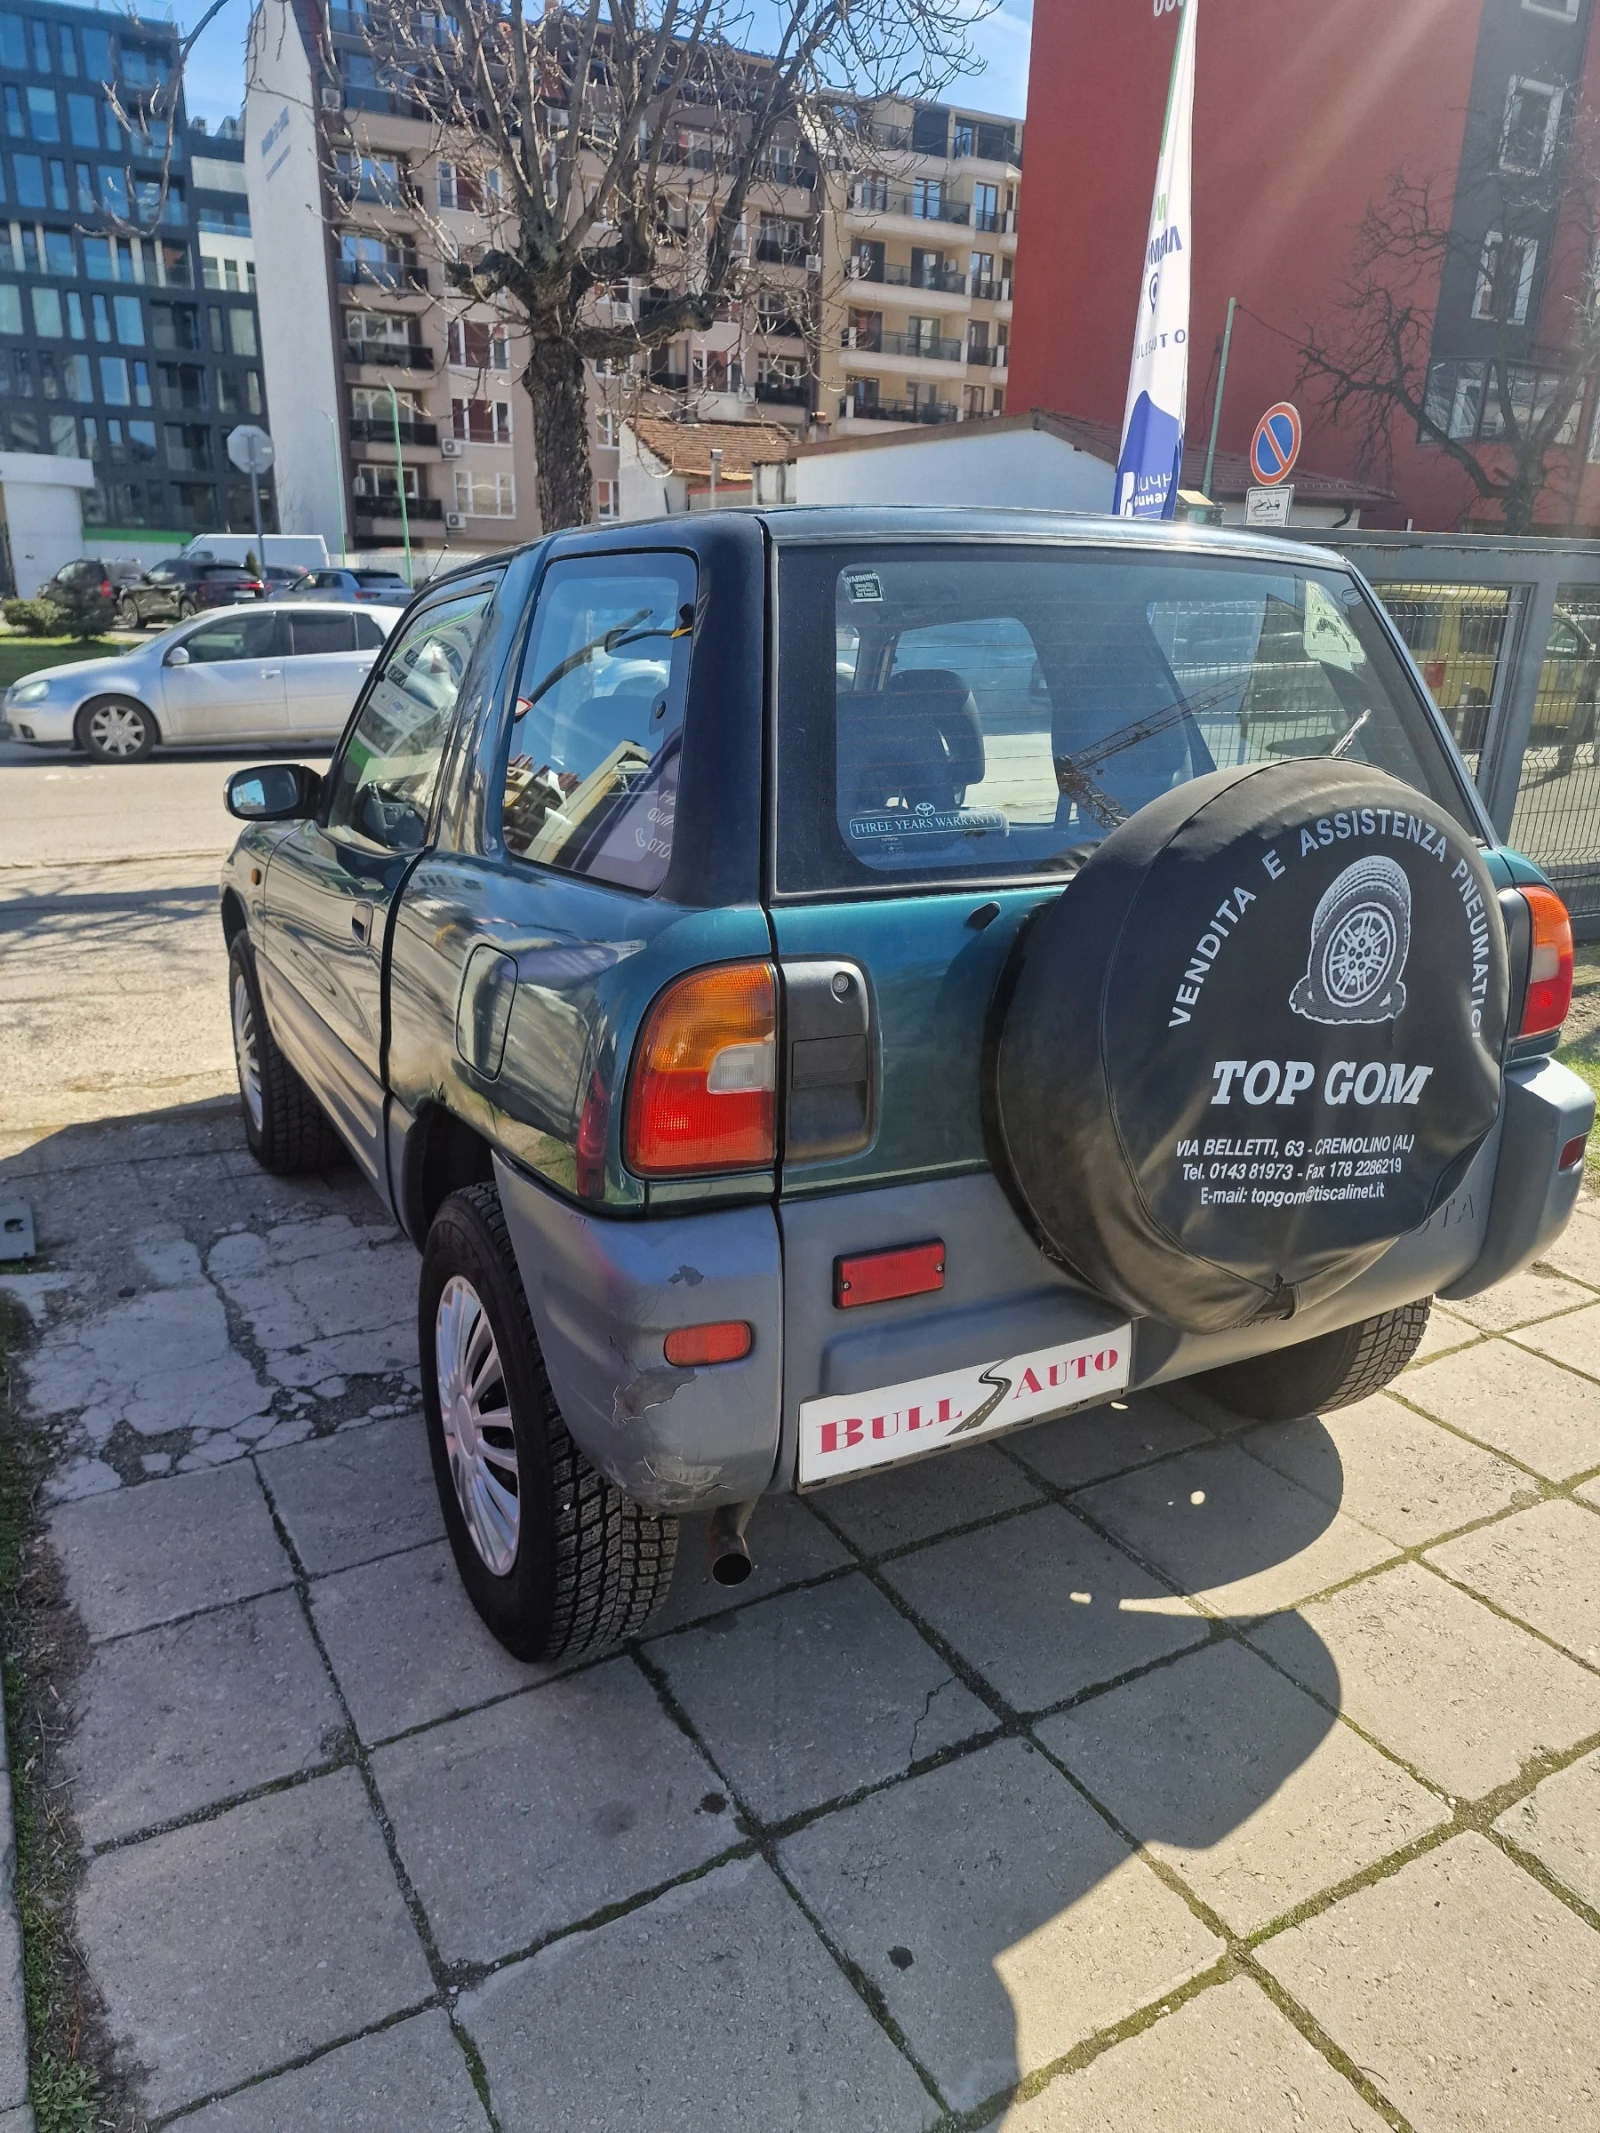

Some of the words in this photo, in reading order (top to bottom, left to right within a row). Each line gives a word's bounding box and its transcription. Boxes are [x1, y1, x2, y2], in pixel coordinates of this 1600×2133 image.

[844, 572, 879, 584] WARNING
[853, 821, 893, 834] THREE
[895, 818, 933, 830] YEARS
[936, 814, 998, 827] WARRANTY
[1168, 886, 1257, 1028] VENDITA
[1261, 849, 1286, 881] E
[1299, 808, 1448, 864] ASSISTENZA
[1451, 858, 1490, 1038] PNEUMATICI
[1210, 1059, 1315, 1105] TOP
[1324, 1060, 1434, 1105] GOM
[1176, 1140, 1199, 1157] VIA
[1203, 1138, 1279, 1159] BELLETTI,
[1284, 1140, 1304, 1157] 63
[1315, 1136, 1391, 1155] CREMOLINO
[1392, 1134, 1415, 1154] (AL)
[1182, 1163, 1205, 1181] Tel.
[1209, 1163, 1247, 1180] 0143
[1249, 1163, 1293, 1180] 81973
[1306, 1163, 1326, 1181] Fax
[1330, 1161, 1352, 1177] 178
[1354, 1157, 1402, 1176] 2286219
[1201, 1186, 1247, 1205] E-mail:
[1251, 1181, 1385, 1207] topgom@tiscalinet.it
[816, 1397, 963, 1457] BULL
[1011, 1349, 1119, 1400] AUTO
